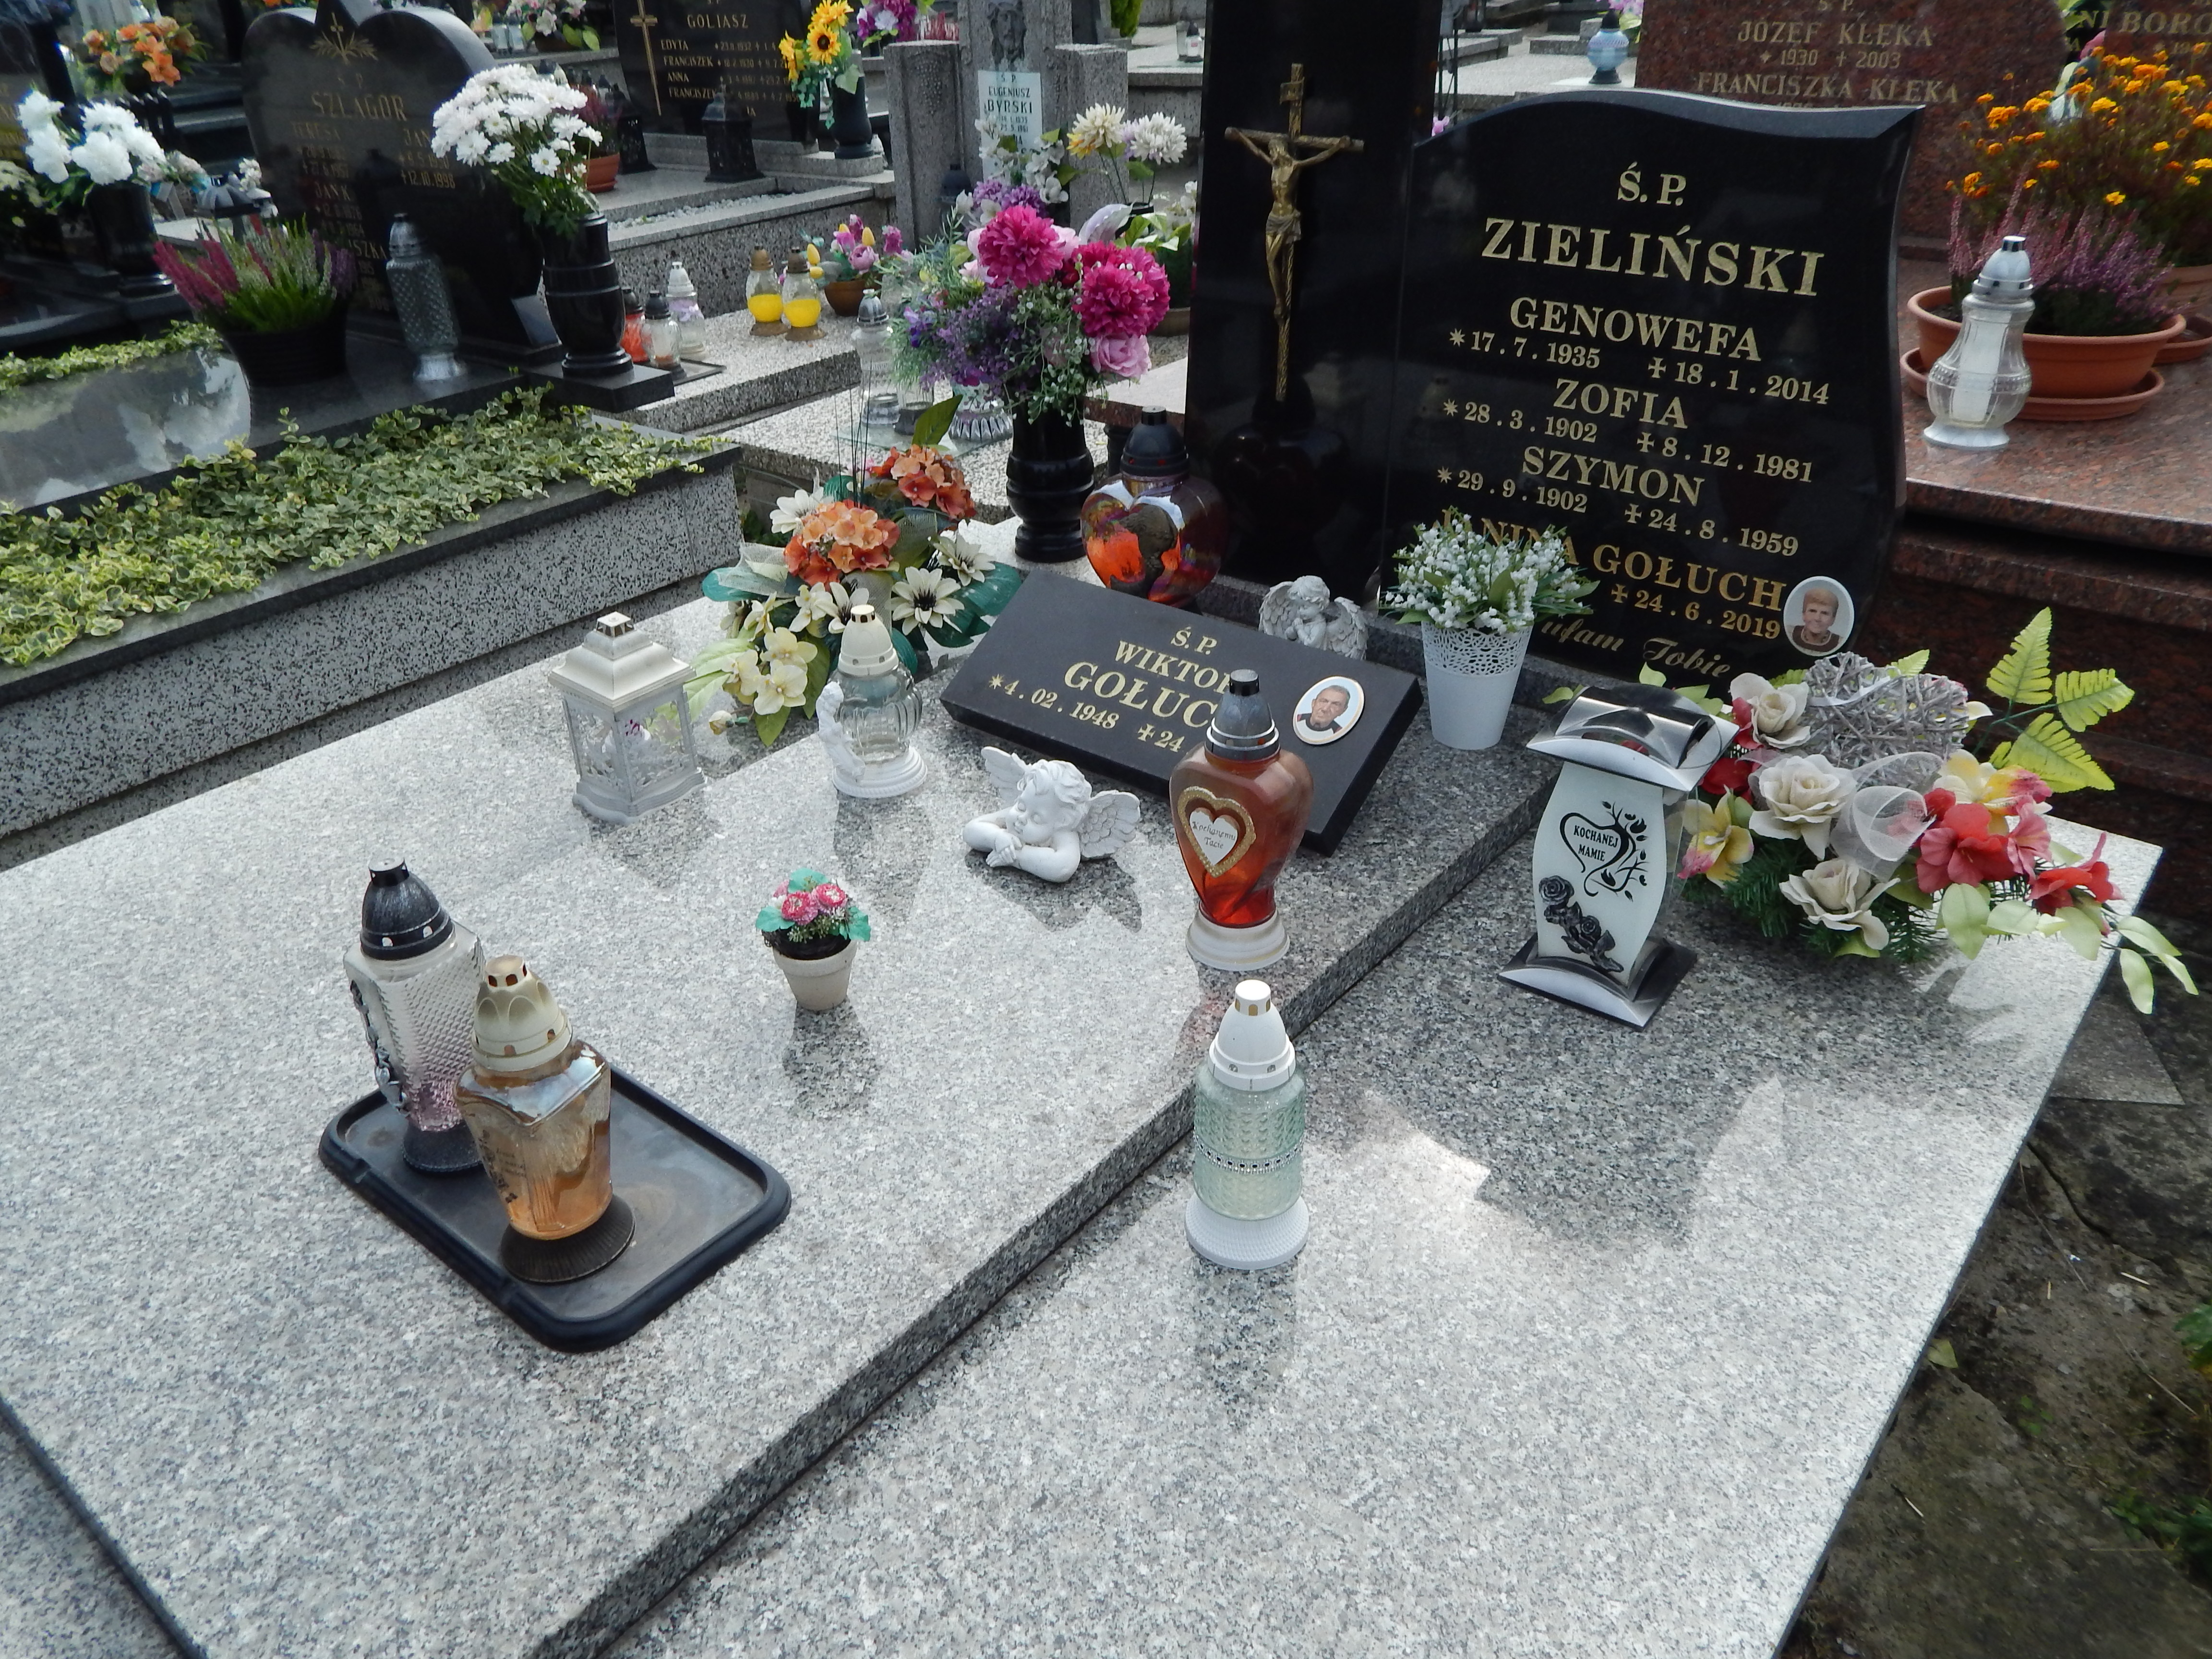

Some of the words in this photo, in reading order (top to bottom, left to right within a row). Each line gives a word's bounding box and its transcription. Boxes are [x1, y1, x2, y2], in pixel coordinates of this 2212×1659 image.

[687, 13, 749, 29] GOLIASZ
[661, 39, 688, 51] EDYTA
[663, 55, 714, 68] FRANCISZEK
[1780, 48, 1818, 66] 1930
[1856, 51, 1901, 69] 2003
[667, 72, 690, 83] ANNA
[1697, 72, 1852, 98] FRANCISZKA
[988, 86, 1031, 98] EUGENIUSZ
[987, 99, 1033, 114] BYRSKI
[1481, 217, 1825, 296] ZIELIŃSKI
[1510, 297, 1762, 362] GENOWEFA
[1553, 378, 1688, 429] ZOFIA
[1522, 445, 1705, 506] SZYMON
[1593, 544, 1787, 612] GOŁUCH
[1642, 637, 1731, 678] Tobie
[1064, 661, 1218, 728] GOŁUC
[1204, 836, 1224, 849] Tacie
[1573, 825, 1619, 848] KOCHANEJ
[1578, 843, 1606, 862] MAMIE
